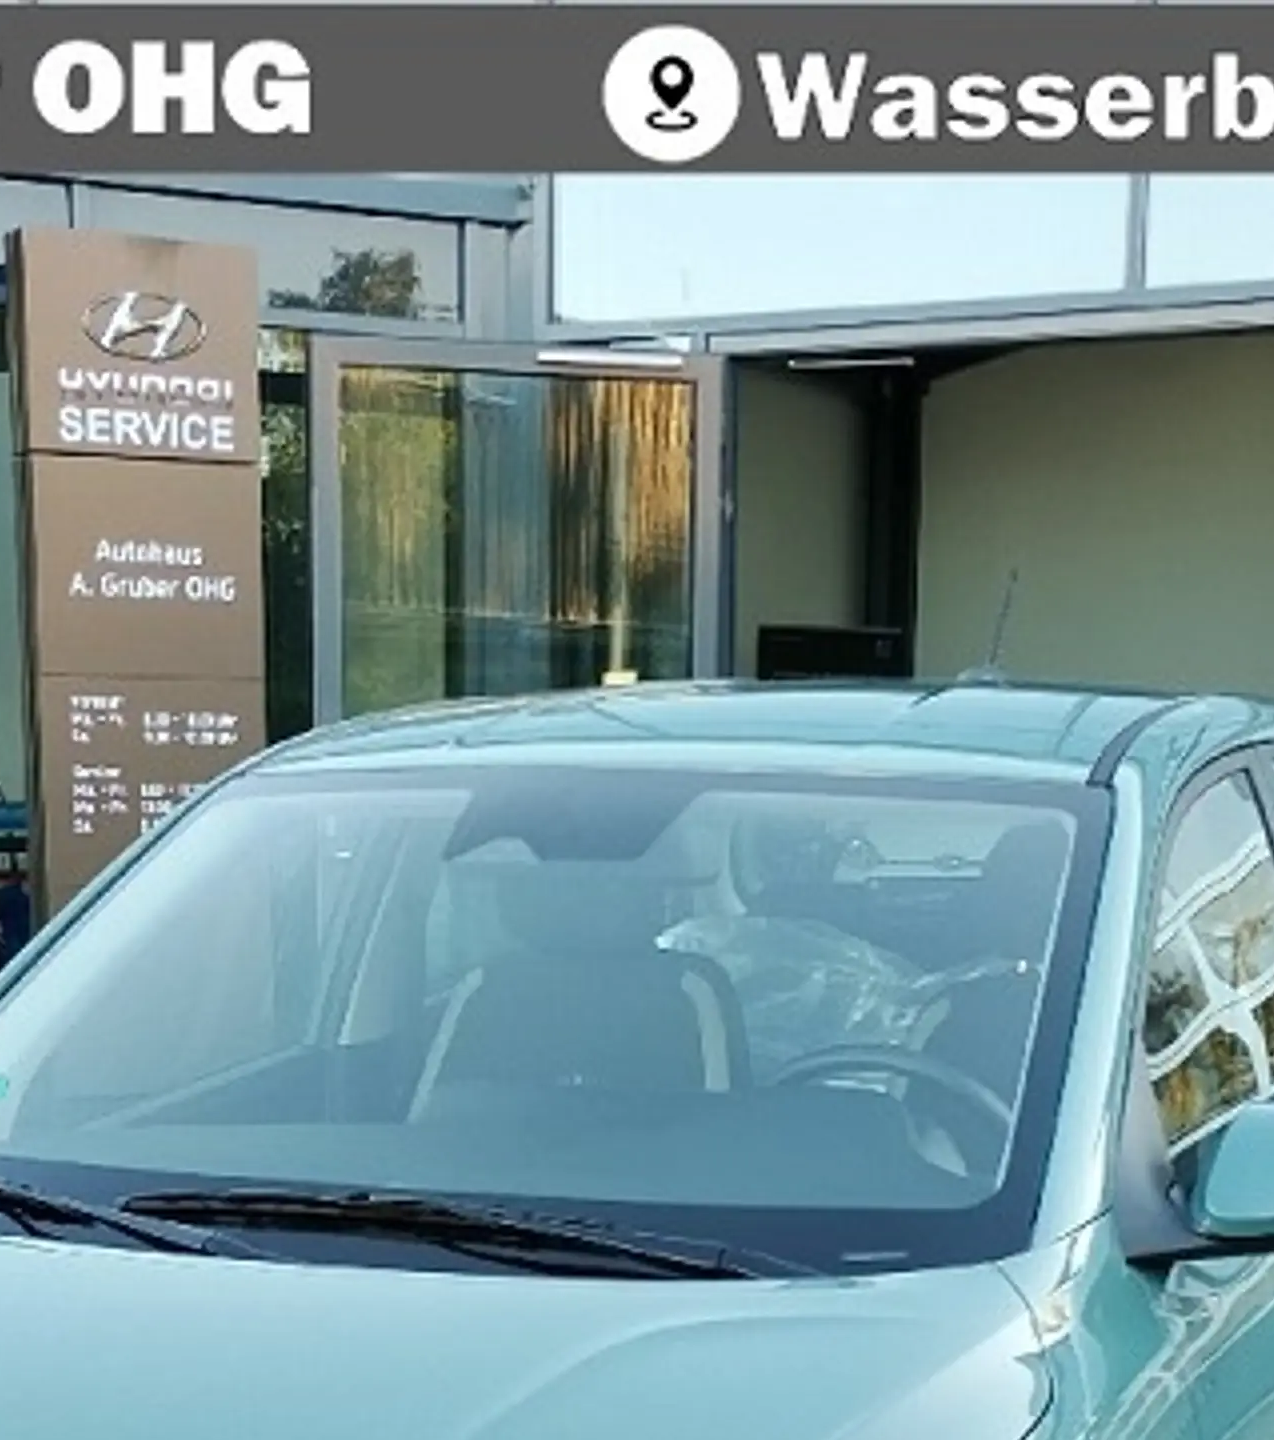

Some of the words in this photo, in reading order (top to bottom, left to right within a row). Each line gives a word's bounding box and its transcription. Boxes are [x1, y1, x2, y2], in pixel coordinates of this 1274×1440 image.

[58, 404, 235, 452] SERVICE
[95, 538, 204, 567] Autohaus
[69, 571, 94, 598] A.
[100, 571, 181, 600] Gruber
[185, 575, 237, 602] OHG
